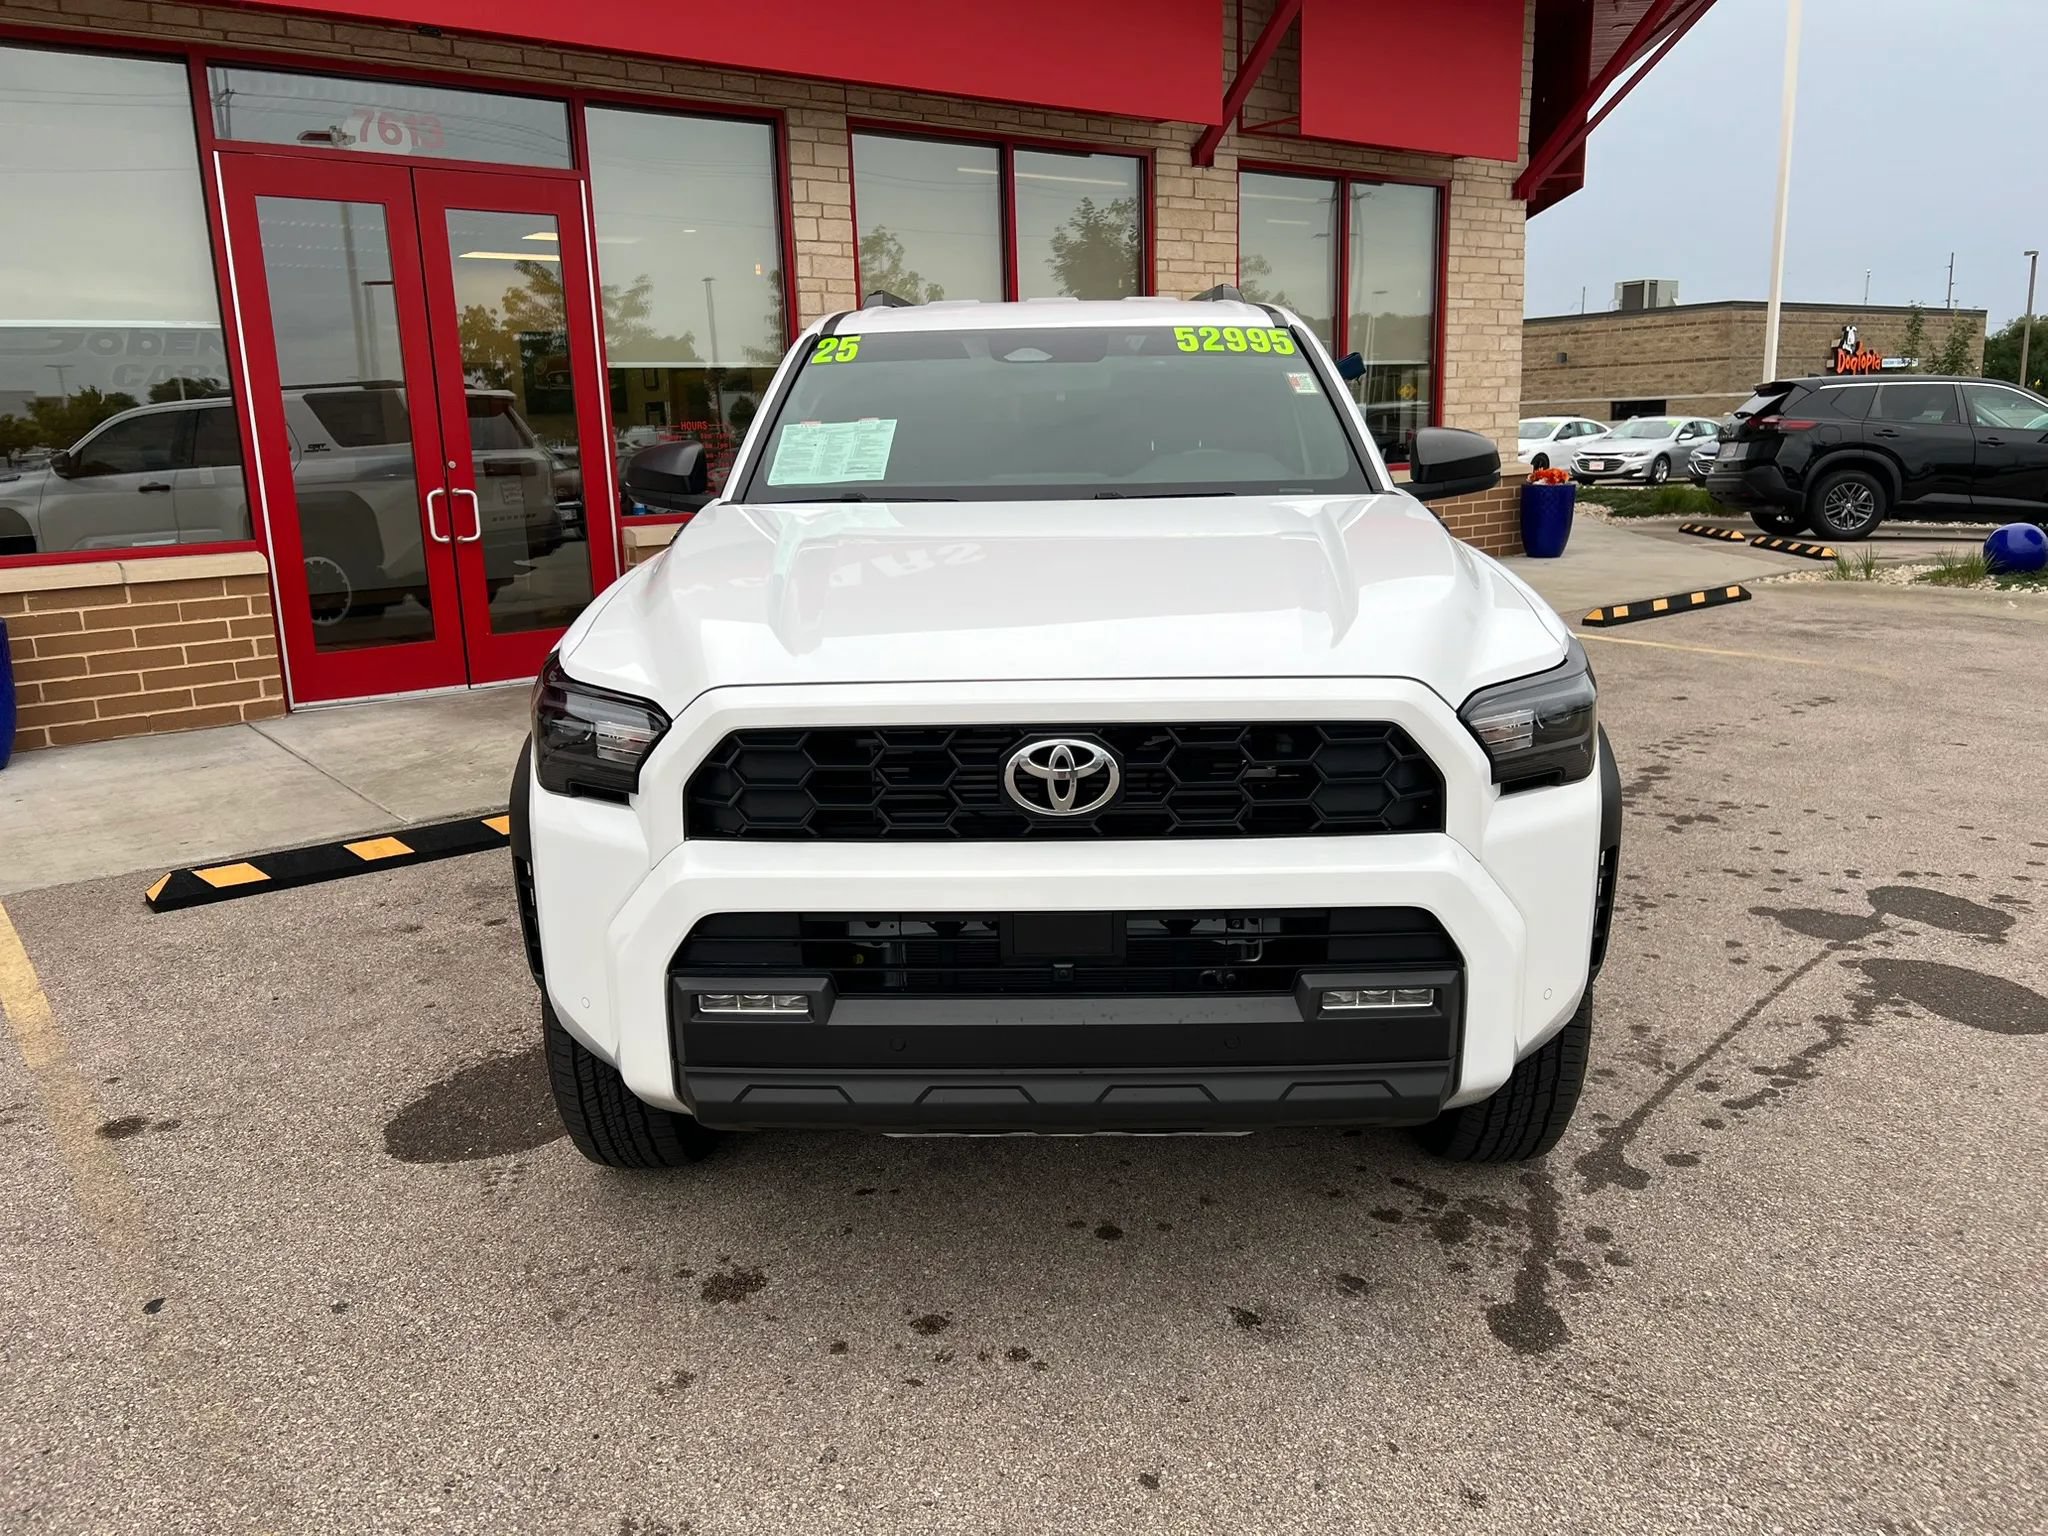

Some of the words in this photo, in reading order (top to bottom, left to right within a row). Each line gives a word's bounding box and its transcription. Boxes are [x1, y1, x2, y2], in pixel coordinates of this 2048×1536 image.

[811, 335, 861, 364] 25
[1173, 326, 1296, 355] 52995
[1837, 343, 1882, 375] Dogtopia
[680, 421, 708, 431] HOURS
